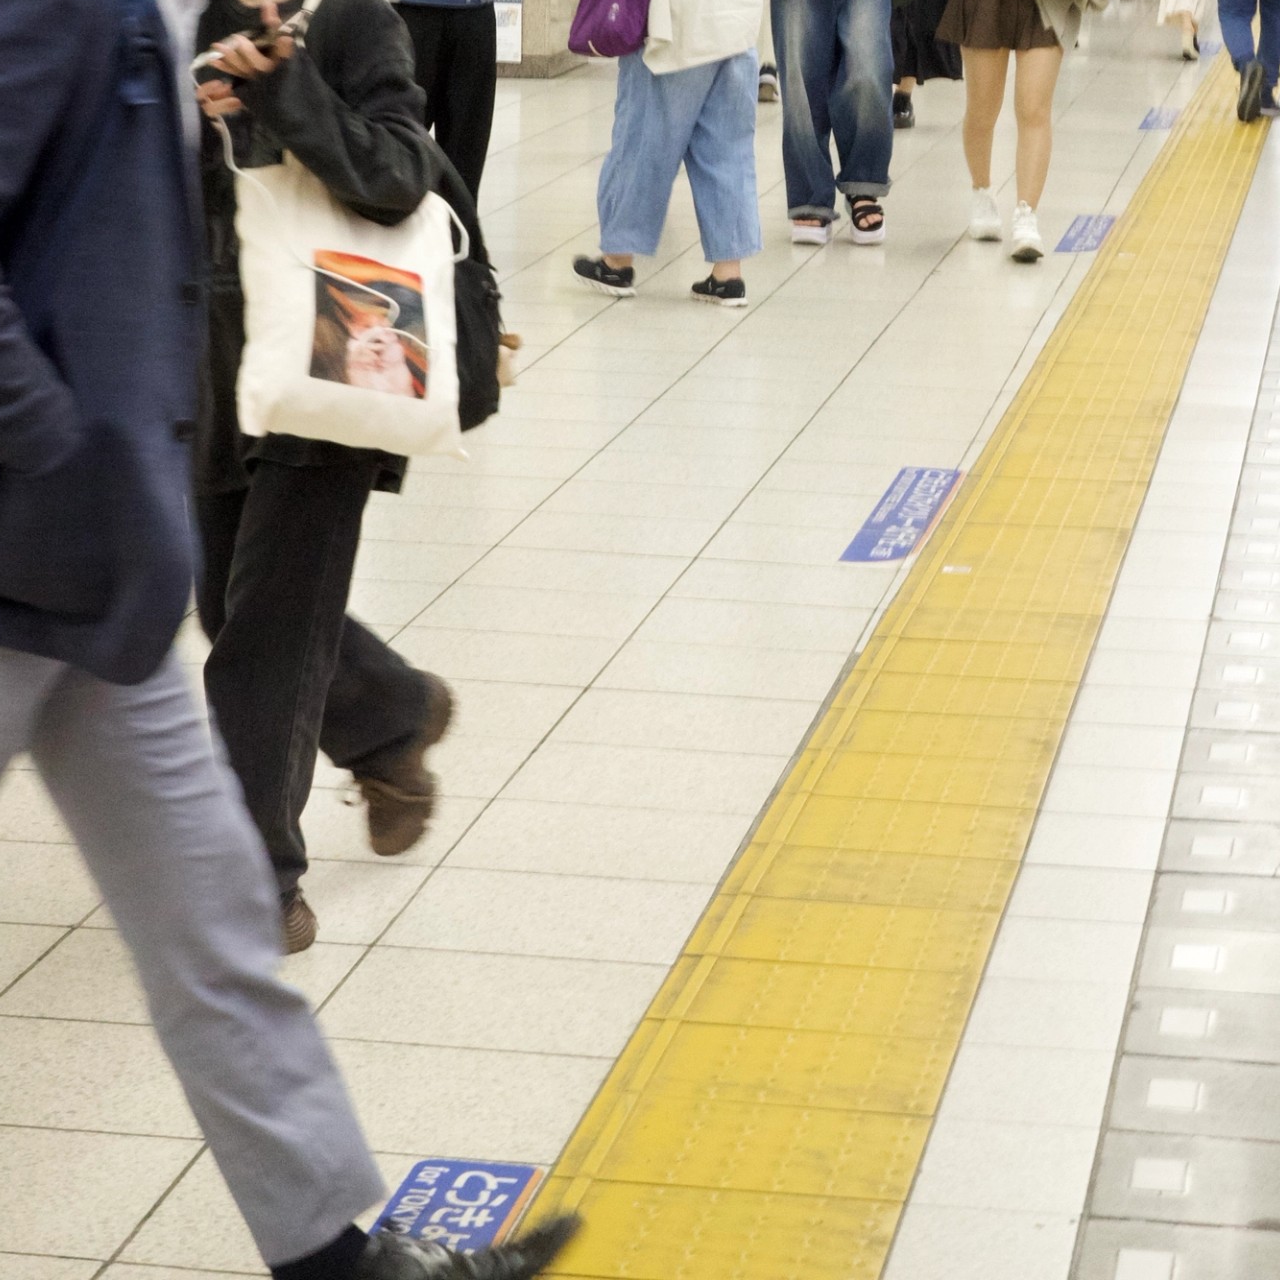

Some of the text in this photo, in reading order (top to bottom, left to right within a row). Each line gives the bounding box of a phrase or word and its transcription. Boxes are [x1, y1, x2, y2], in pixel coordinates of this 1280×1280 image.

[412, 1165, 450, 1186] for
[420, 1170, 518, 1256] とうきょ
